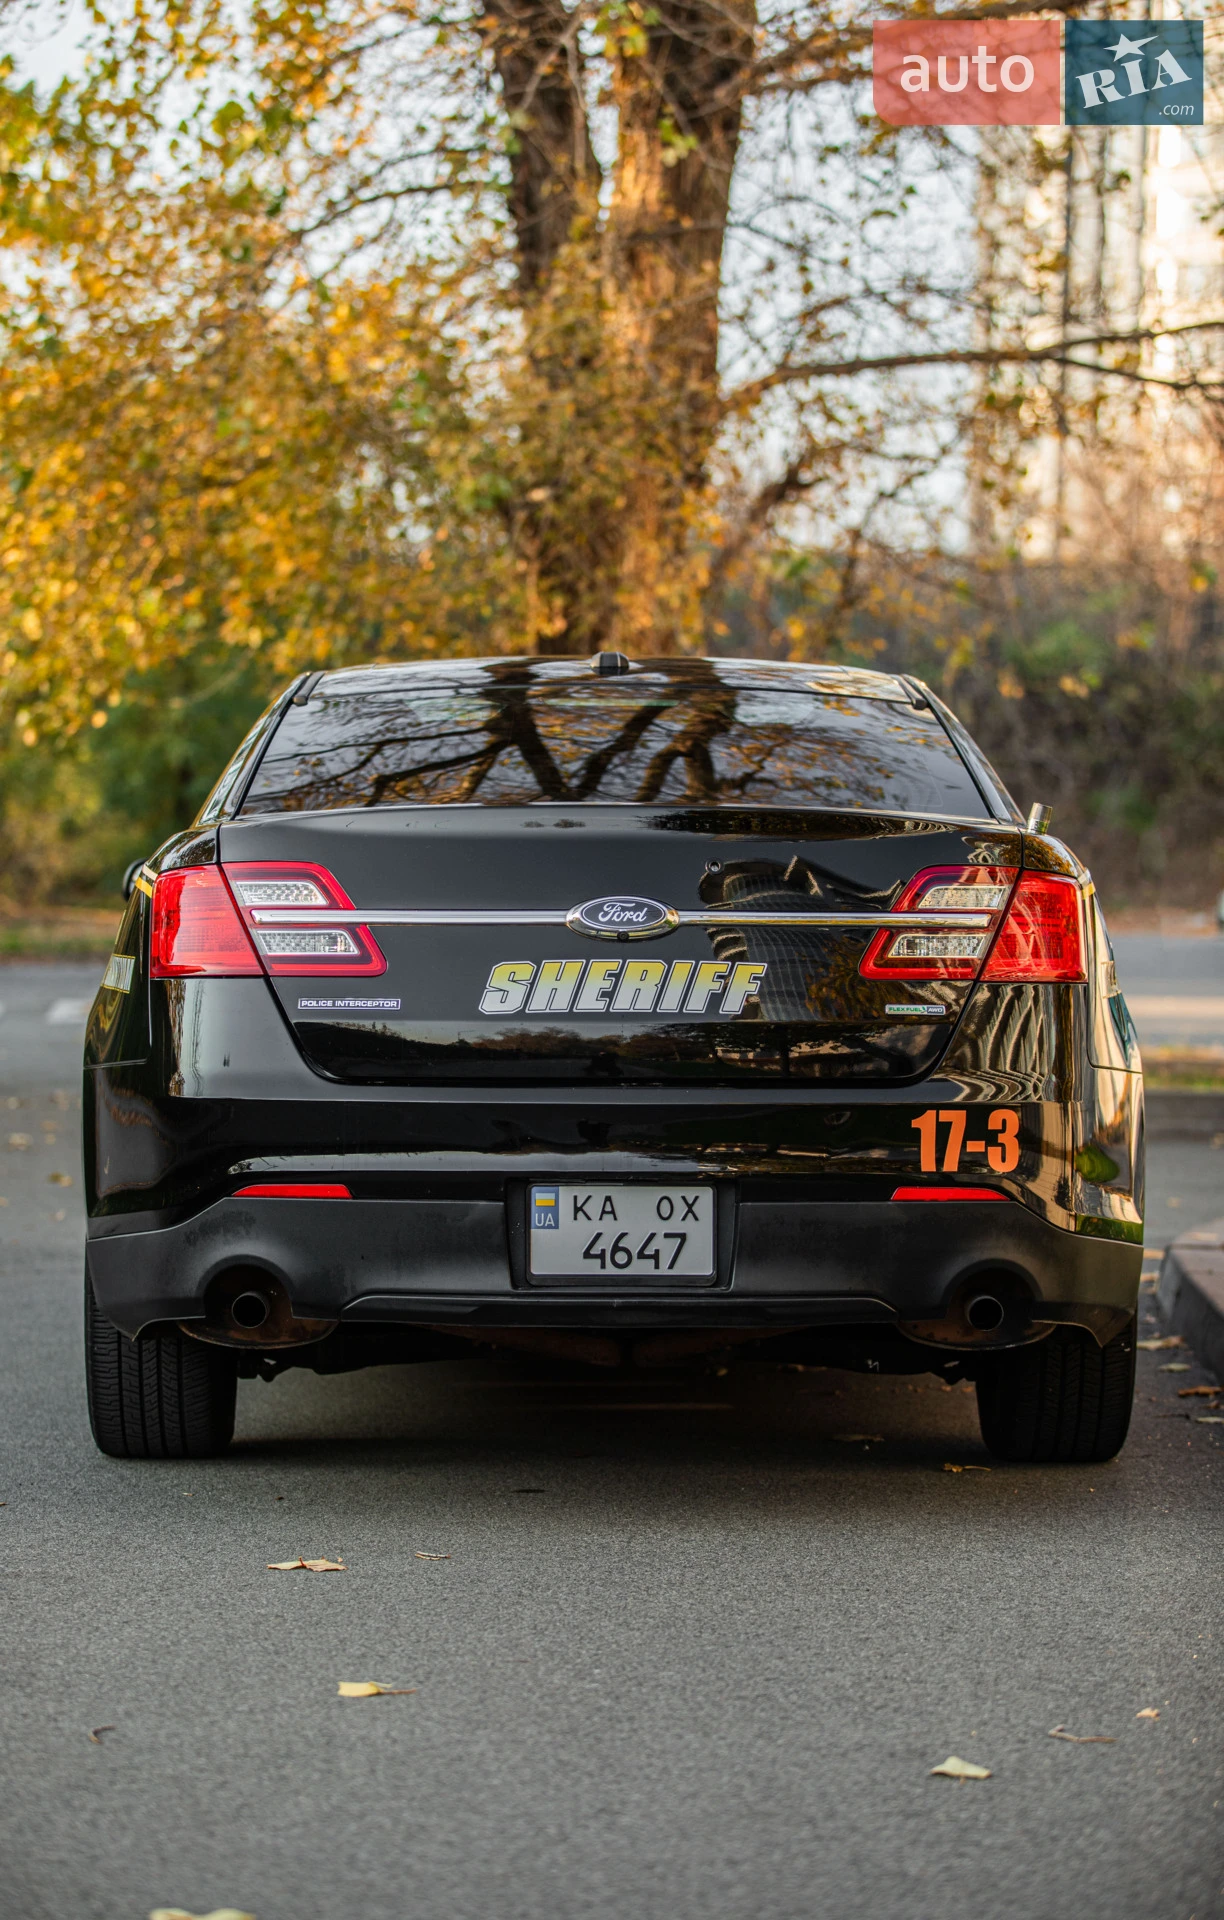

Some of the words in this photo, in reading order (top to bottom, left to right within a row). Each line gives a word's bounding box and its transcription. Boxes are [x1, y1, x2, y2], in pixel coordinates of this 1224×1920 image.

[598, 902, 648, 922] Ford
[478, 959, 768, 1015] SHERIFF
[911, 1108, 1020, 1173] 17-3
[535, 1213, 555, 1227] UA
[573, 1194, 618, 1221] KA
[656, 1195, 700, 1221] OX
[582, 1232, 687, 1270] 4647
